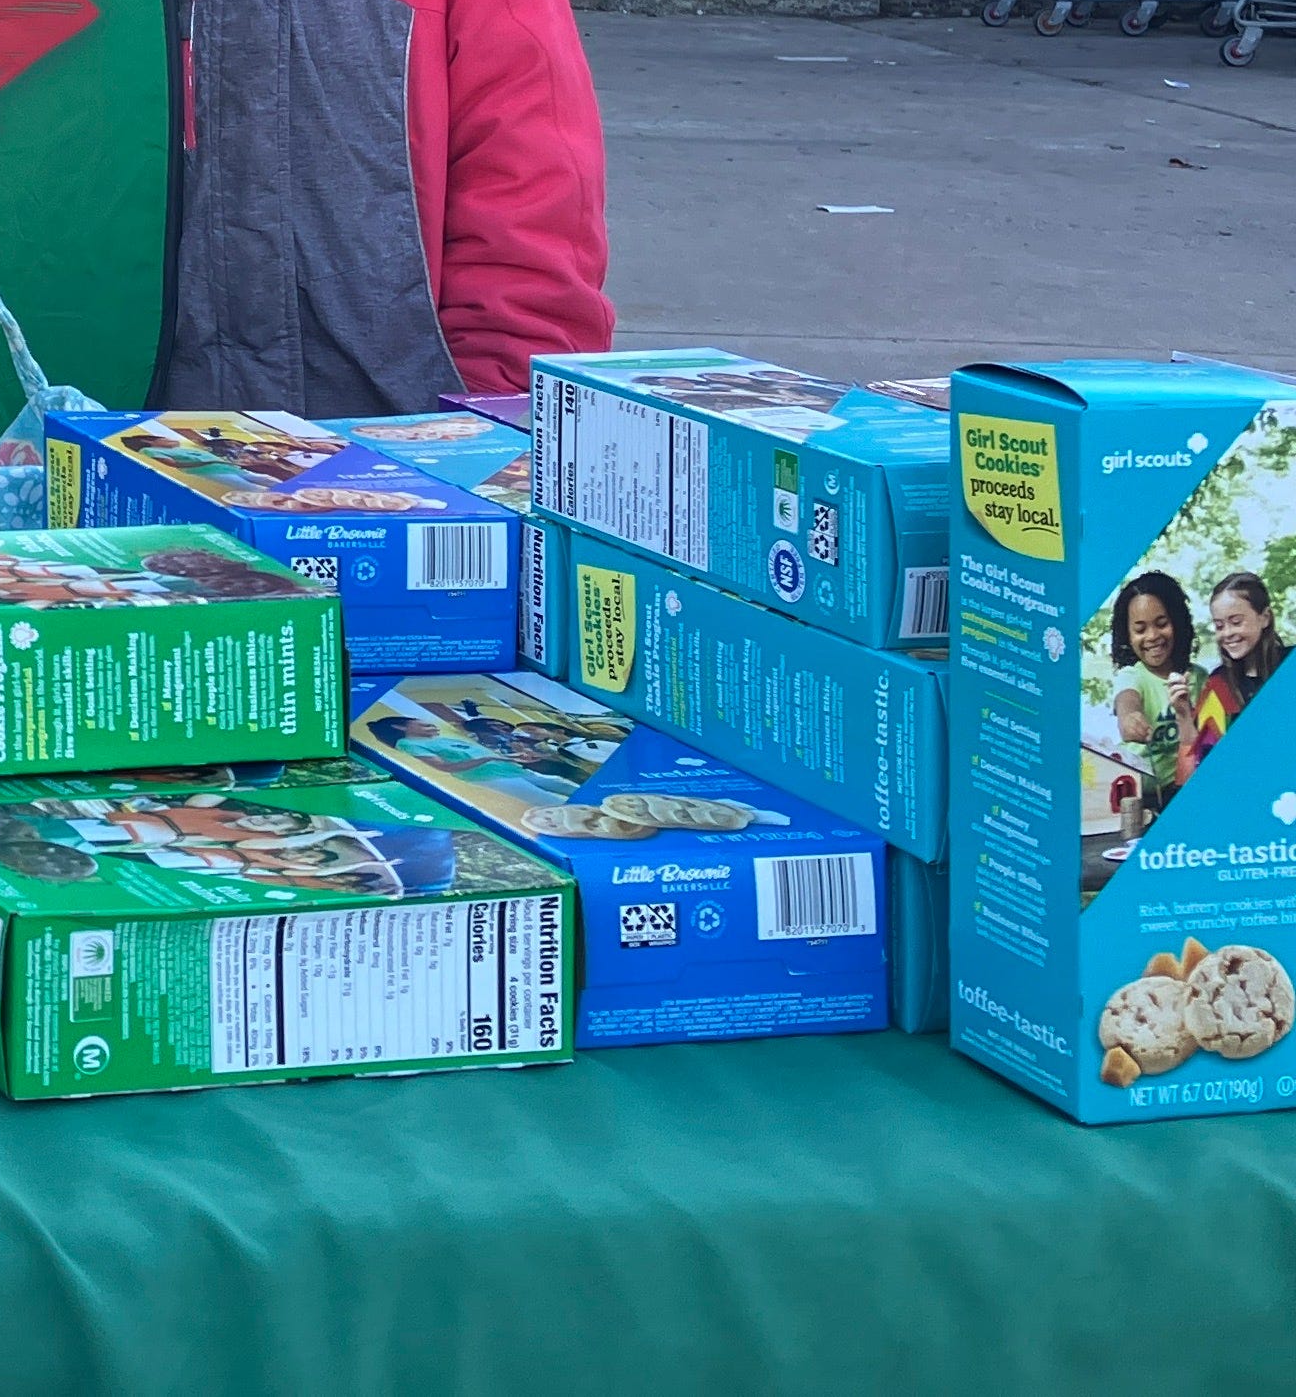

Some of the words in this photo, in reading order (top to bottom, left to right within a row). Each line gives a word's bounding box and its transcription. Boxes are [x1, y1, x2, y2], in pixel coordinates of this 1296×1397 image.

[534, 374, 544, 422] Facts
[565, 383, 576, 416] 140
[966, 429, 996, 450] Girl
[999, 435, 1049, 456] Scout
[1102, 450, 1132, 473] girl
[1135, 451, 1192, 469] scouts
[534, 427, 544, 506] Nutrition
[975, 453, 1041, 477] Cookies
[566, 461, 575, 517] Calories
[971, 478, 1035, 501] proceeds
[286, 525, 323, 541] Little
[324, 524, 387, 540] Brownie
[985, 503, 1015, 527] stay
[1018, 509, 1060, 528] local.
[533, 529, 544, 608] Nutrition
[779, 556, 794, 588] NSF
[961, 554, 983, 573] The
[985, 564, 1008, 582] Girl
[1010, 573, 1045, 595] Scout
[961, 572, 1001, 596] Cookie
[582, 573, 593, 633] Scout
[612, 574, 623, 624] local.
[127, 632, 139, 676] Making
[533, 612, 544, 662] Facts
[602, 597, 618, 681] proceeds
[613, 629, 625, 667] stay
[85, 648, 96, 689] Setting
[584, 639, 597, 677] Girl
[129, 679, 139, 729] Decision
[279, 691, 297, 735] thin
[611, 865, 655, 885] Little
[658, 864, 731, 882] Brownie
[1218, 866, 1296, 881] GLUTEN-FRE
[1173, 902, 1219, 918] buttery
[1223, 898, 1273, 912] cookies
[1183, 914, 1238, 930] crunchy
[1241, 913, 1278, 927] toffee
[472, 902, 489, 963] Calories
[539, 896, 559, 985] Nutrition
[510, 985, 518, 1022] cookies
[539, 992, 559, 1048] Facts
[473, 1014, 493, 1051] 160
[1130, 1086, 1158, 1106] NET
[1160, 1083, 1180, 1105] WT
[1183, 1082, 1201, 1102] 6.7
